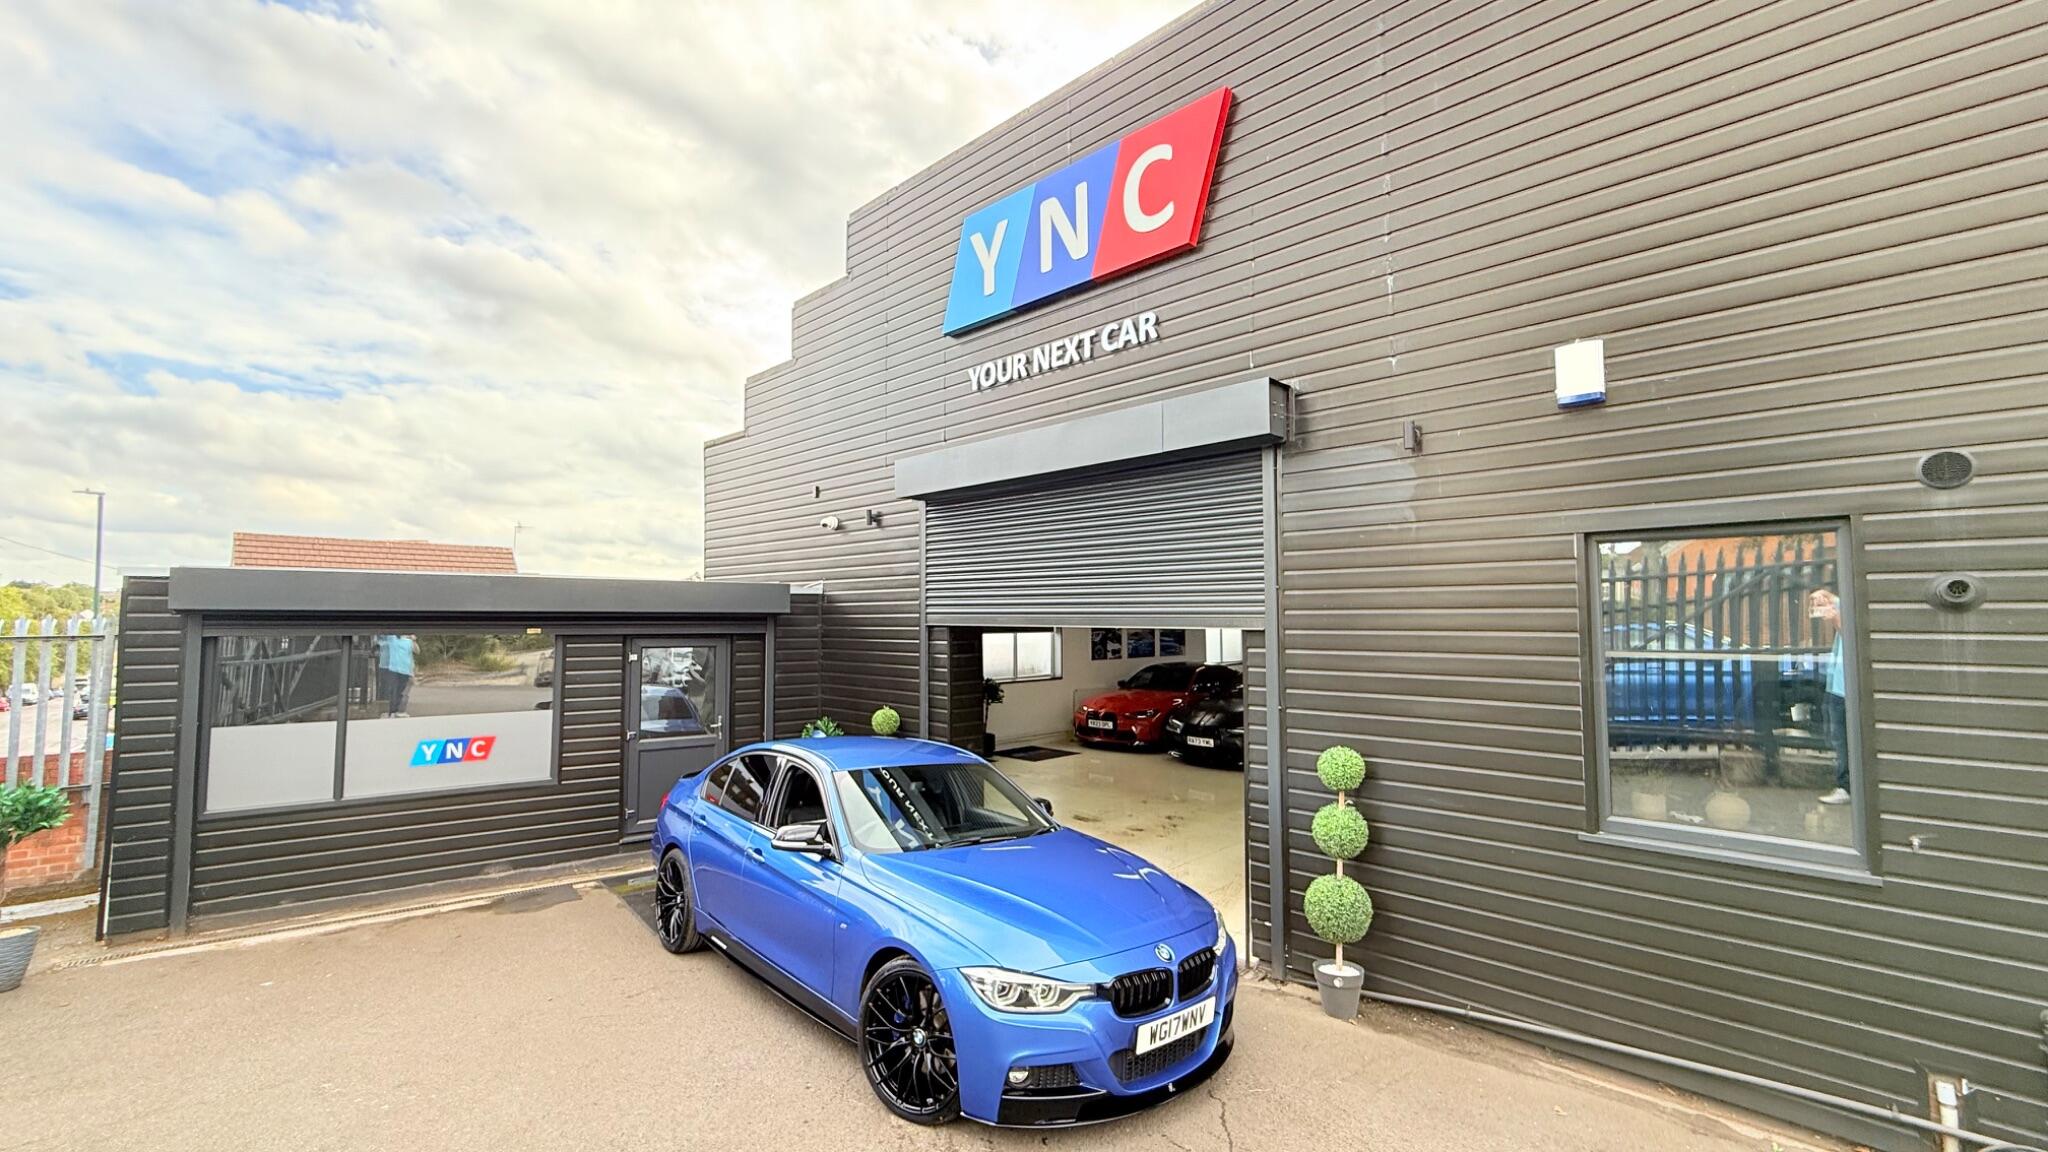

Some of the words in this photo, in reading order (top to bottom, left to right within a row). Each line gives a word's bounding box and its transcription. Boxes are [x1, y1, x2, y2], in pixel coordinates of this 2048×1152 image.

[970, 143, 1175, 297] YNC
[968, 353, 1028, 390] YOUR
[1033, 330, 1096, 374] NEXT
[1101, 312, 1158, 352] CAR
[422, 741, 486, 761] YNC
[1149, 1004, 1206, 1045] WG17WNV
